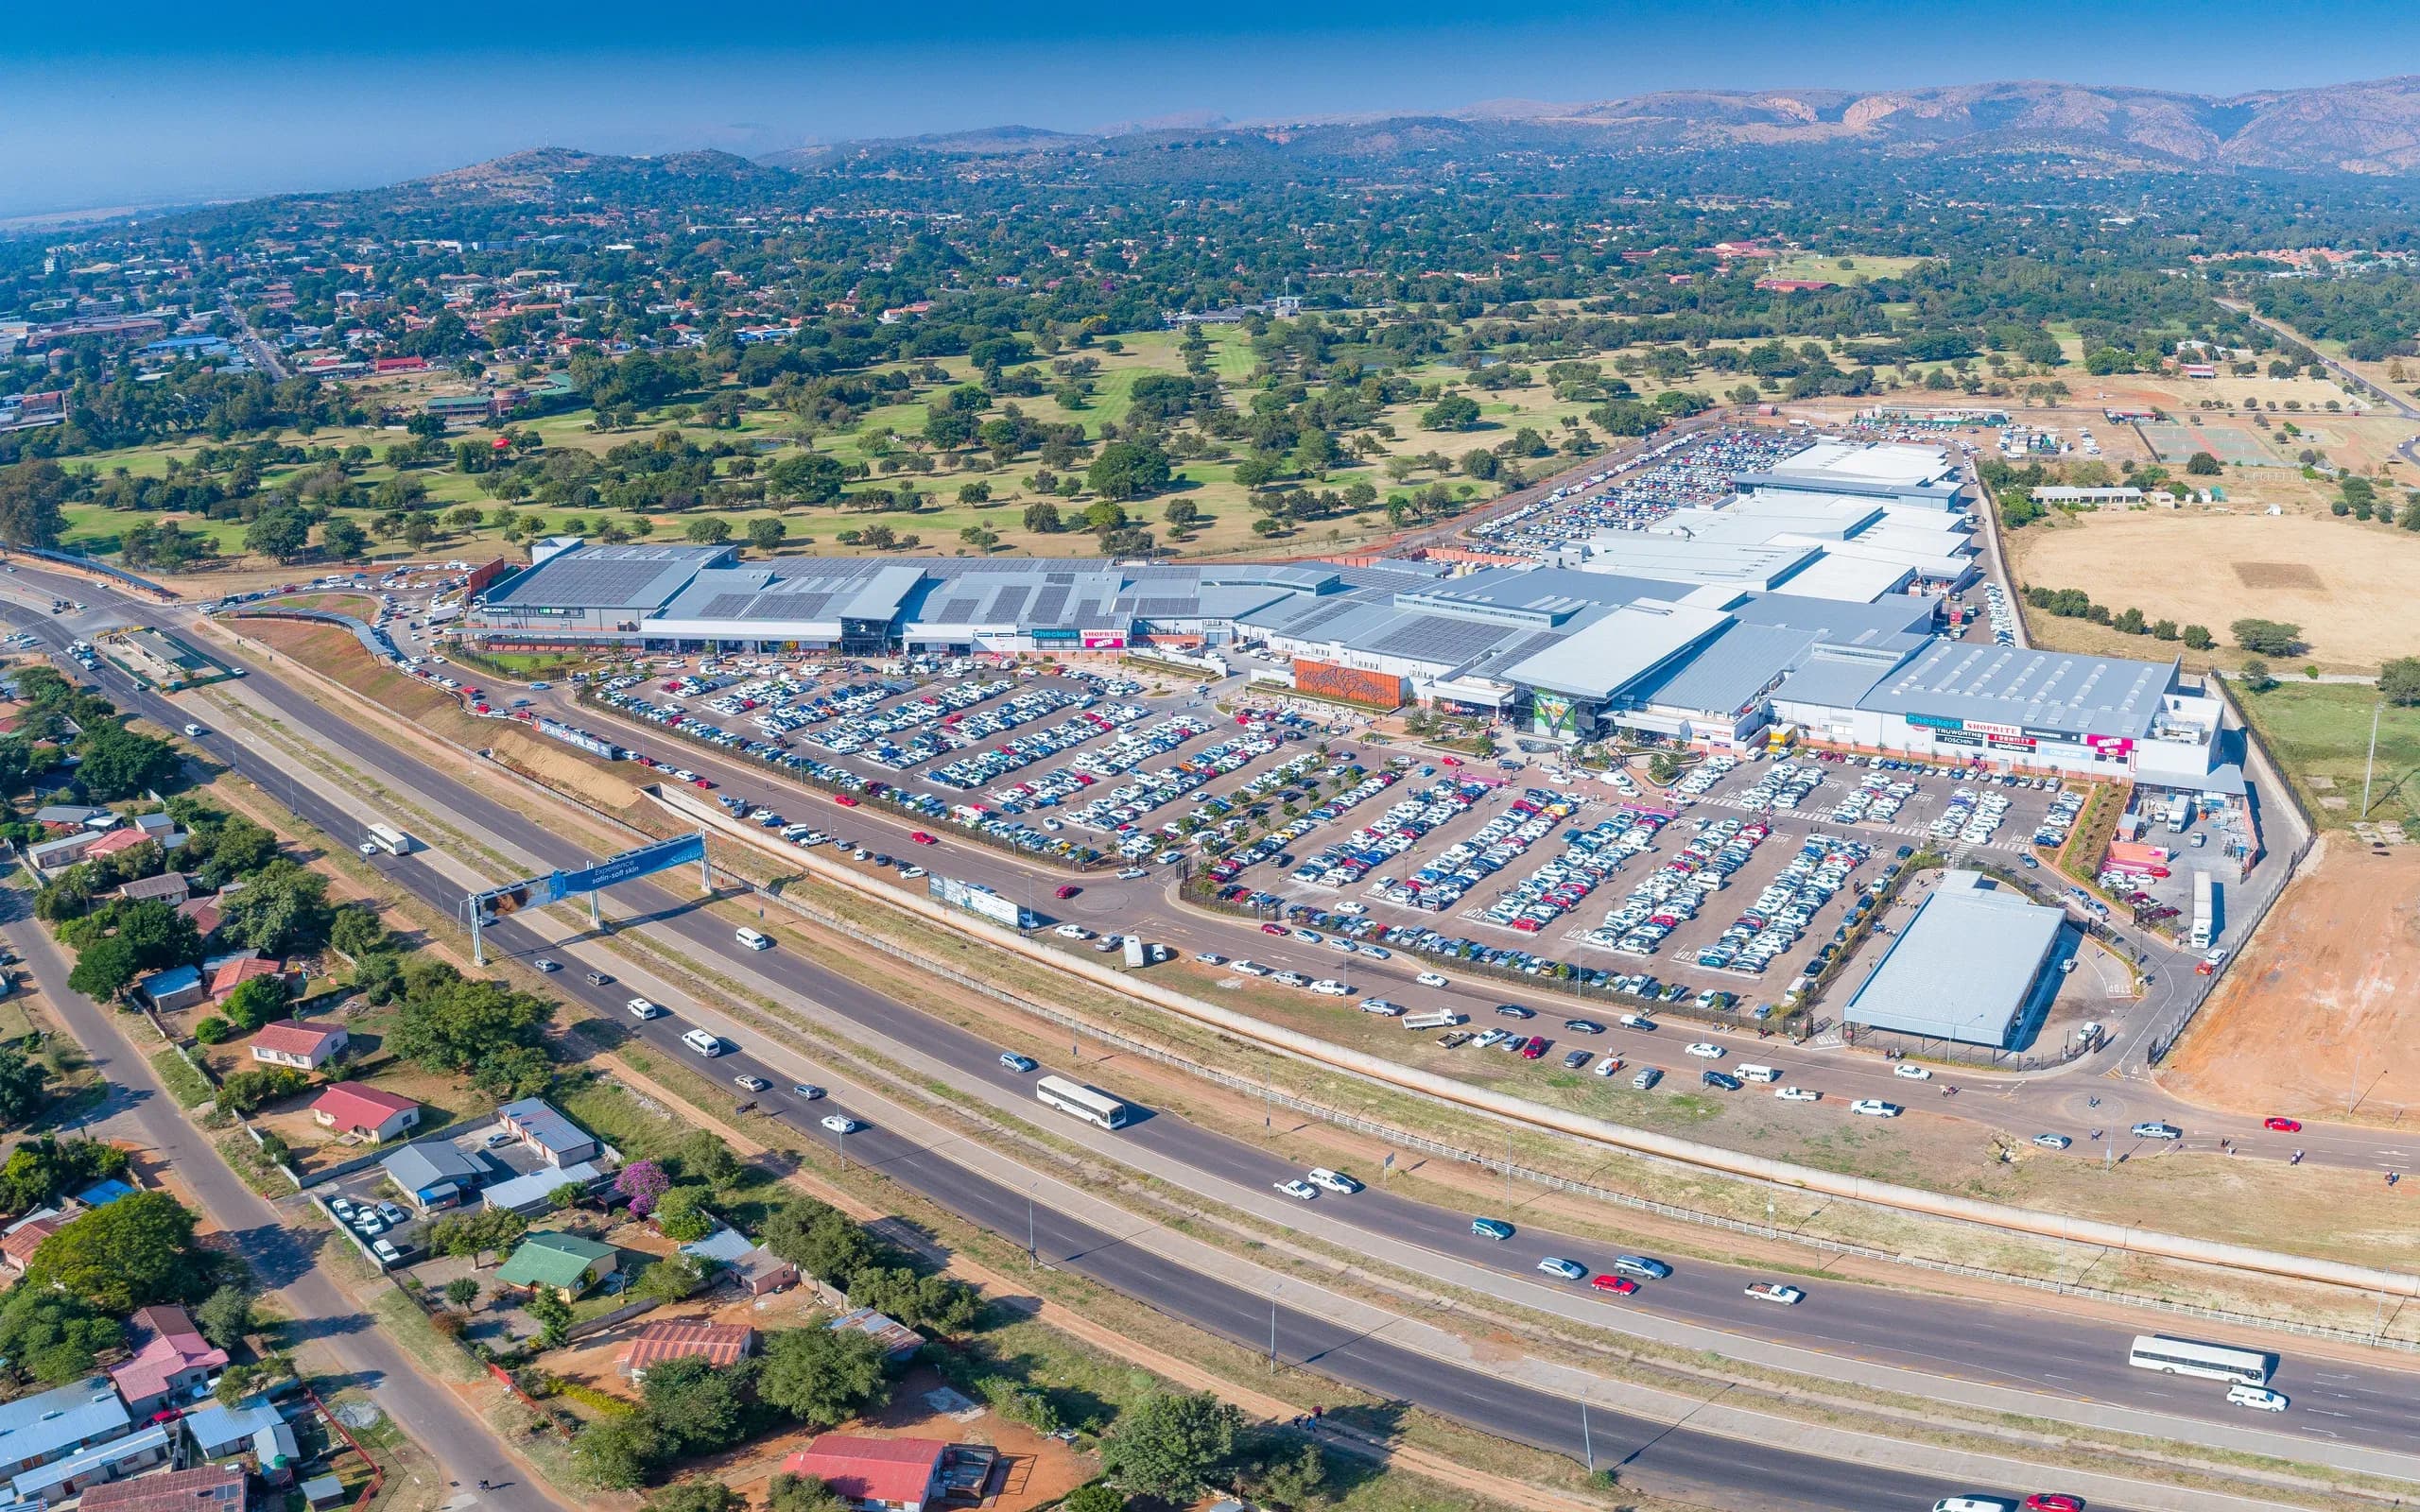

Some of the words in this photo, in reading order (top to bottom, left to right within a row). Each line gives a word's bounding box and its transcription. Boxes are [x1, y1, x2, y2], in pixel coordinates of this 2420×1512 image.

[859, 624, 866, 632] 2
[1032, 629, 1078, 639] Checkers
[1276, 695, 1354, 718] RUSTENBURG
[1907, 714, 1962, 729] Checkers
[1936, 728, 1982, 738] TRUWORTHS
[1966, 723, 2017, 734] SHOPRITE
[1944, 736, 1974, 746] FOSCHINI
[2097, 738, 2122, 747] game
[669, 850, 702, 865] Satiskin
[595, 859, 635, 876] Experience
[592, 870, 624, 885] satin-soft
[625, 865, 639, 876] skin
[2108, 983, 2132, 994] STOP
[1815, 1034, 1840, 1045] STOP
